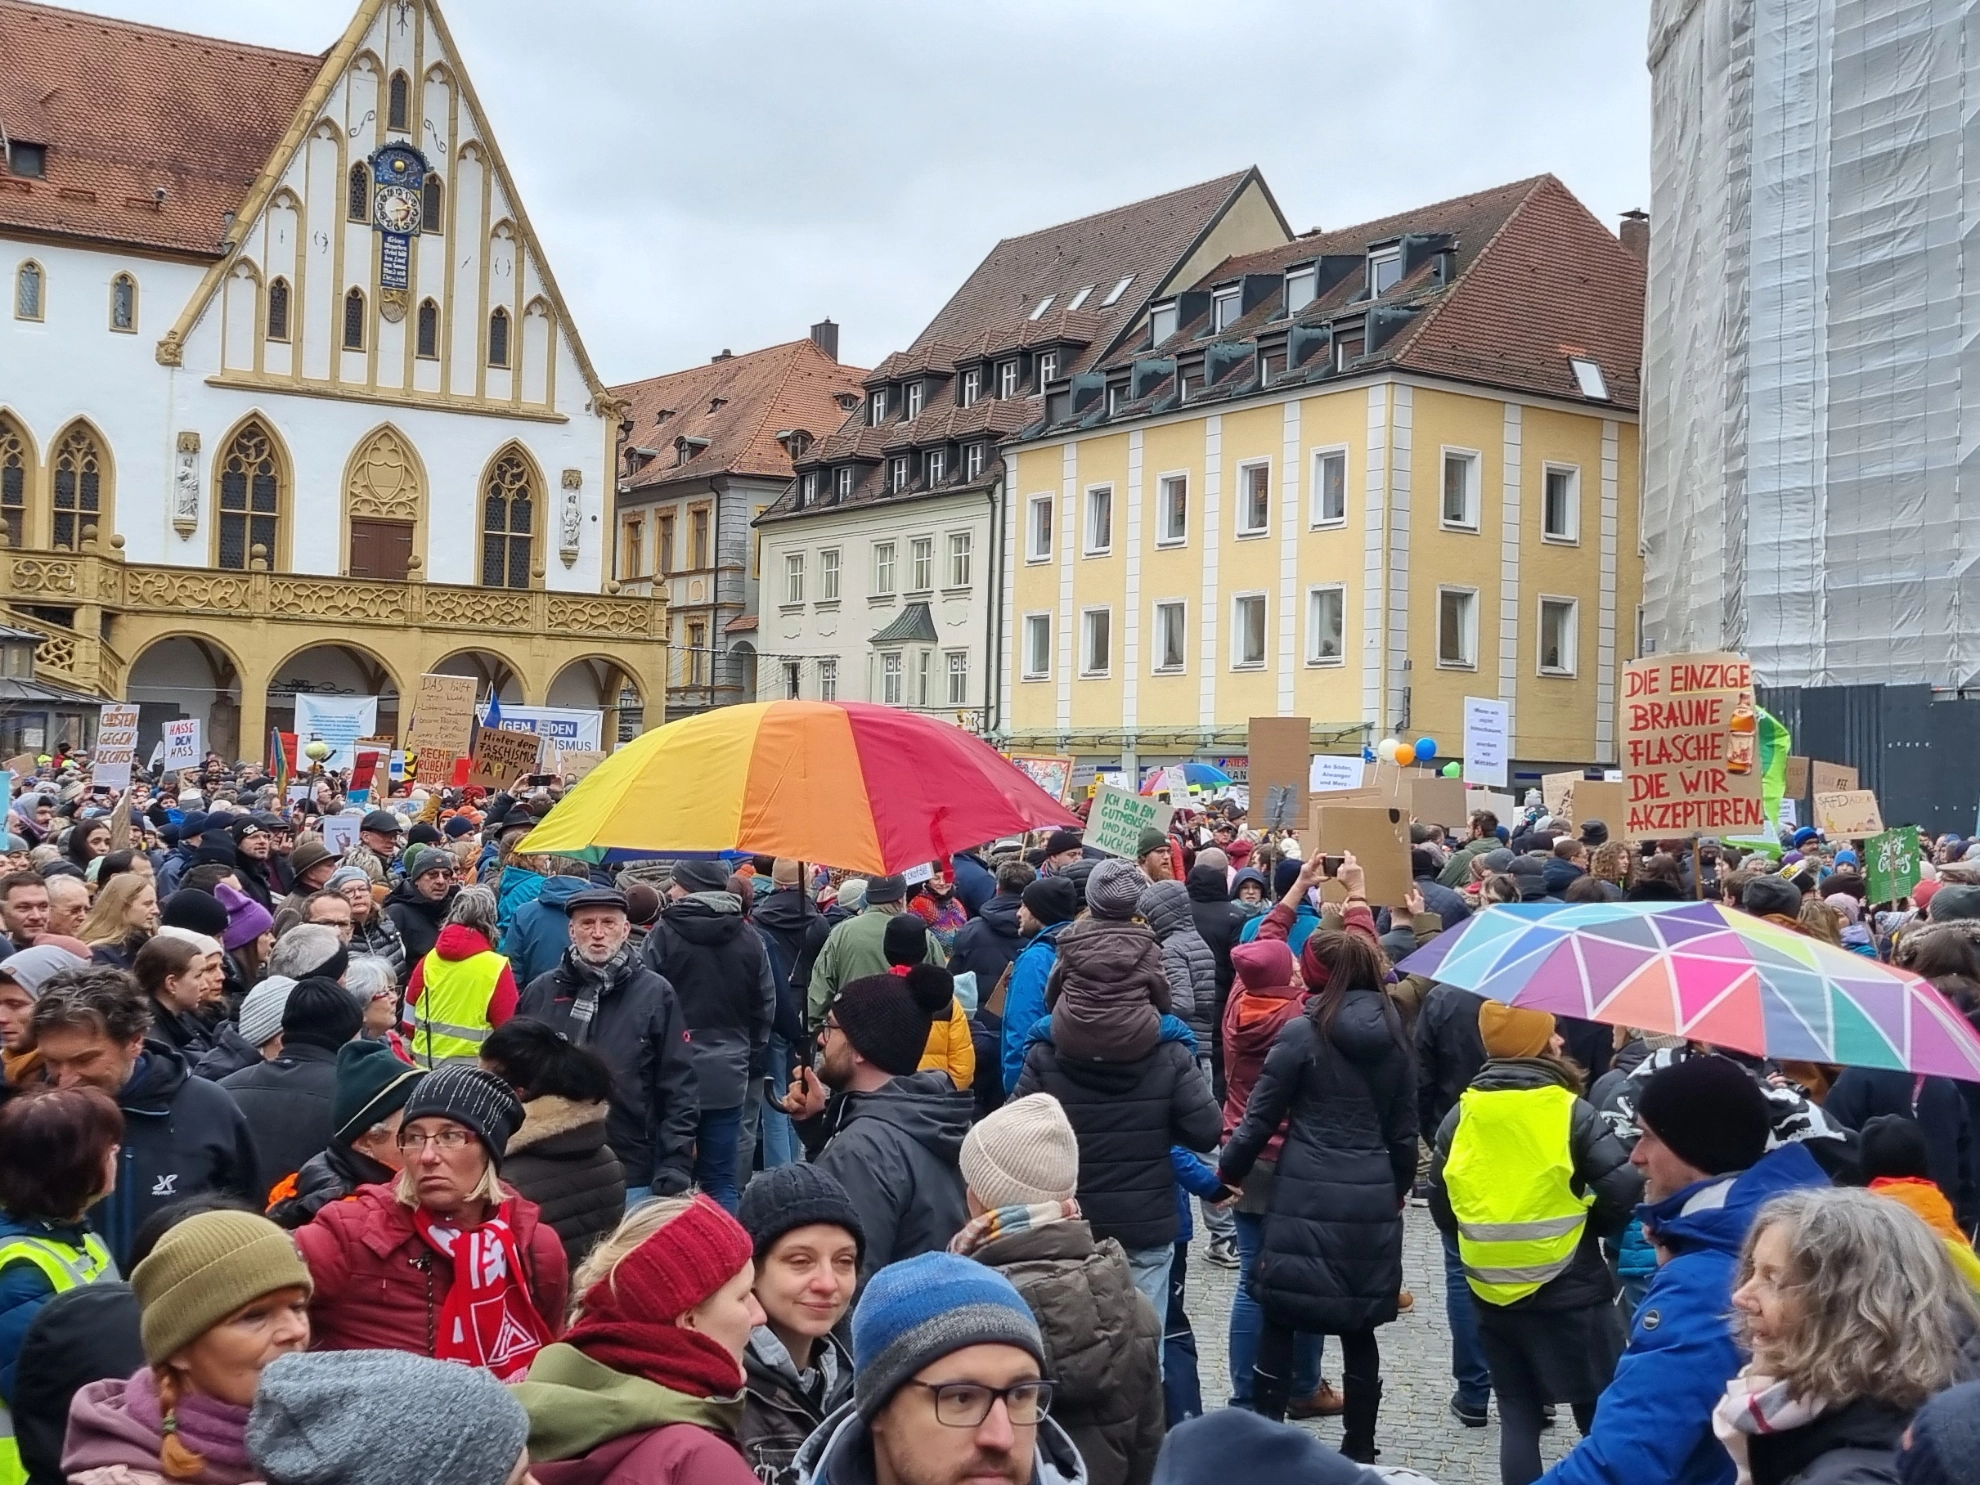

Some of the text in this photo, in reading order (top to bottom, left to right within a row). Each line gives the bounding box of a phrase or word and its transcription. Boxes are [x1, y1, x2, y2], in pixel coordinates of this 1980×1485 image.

[421, 677, 444, 692] DAS
[1625, 664, 1751, 698] DIE EINZIGE
[1629, 699, 1723, 731] BRAUNE
[170, 723, 194, 735] HASSE
[500, 720, 531, 731] GEN
[551, 723, 574, 735] DEN
[100, 732, 135, 745] GEGEN
[175, 736, 192, 746] DEN
[484, 731, 537, 751] Hinter dem
[554, 740, 591, 751] ISMUS
[97, 750, 132, 764] RECHTS
[170, 746, 193, 758] HASS
[480, 743, 537, 764] FASCHISMUS
[1628, 733, 1724, 766] FLASCHE
[1627, 768, 1729, 803] DIE WIR
[1104, 792, 1157, 820] ICH BIN EIN
[1626, 797, 1764, 833] AKZEPTIEREN.
[1101, 806, 1152, 829] GUTMENSC
[1102, 820, 1138, 840] UND DAS
[1096, 832, 1140, 858] AUCH GU
